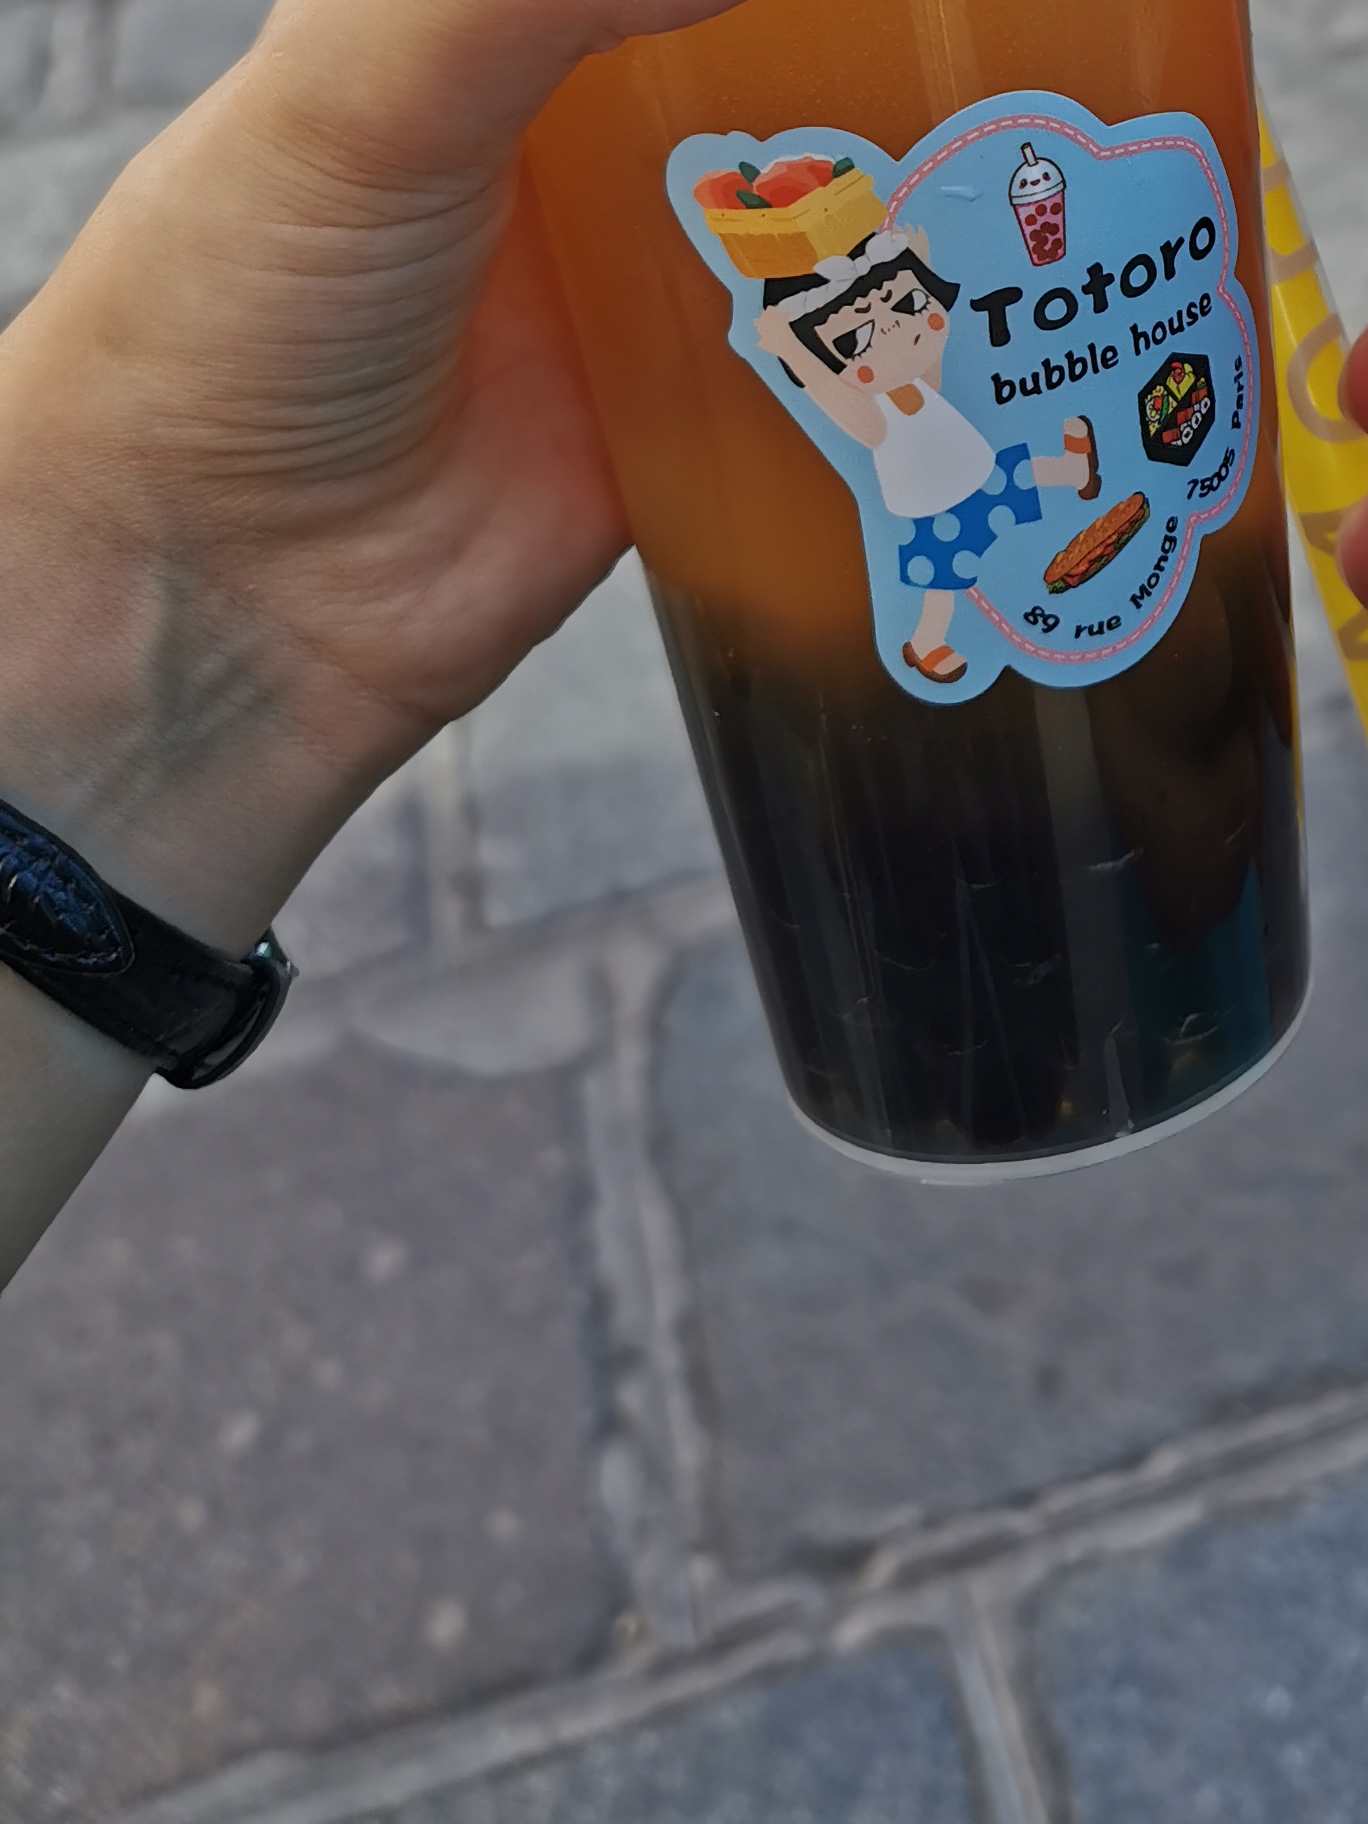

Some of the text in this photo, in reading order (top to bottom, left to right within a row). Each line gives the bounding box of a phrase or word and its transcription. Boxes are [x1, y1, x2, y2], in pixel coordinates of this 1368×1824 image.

[969, 216, 1217, 347] Totoro
[990, 292, 1213, 406] bubble house
[1023, 355, 1245, 640] 89 rue Monge 75005 Paris
